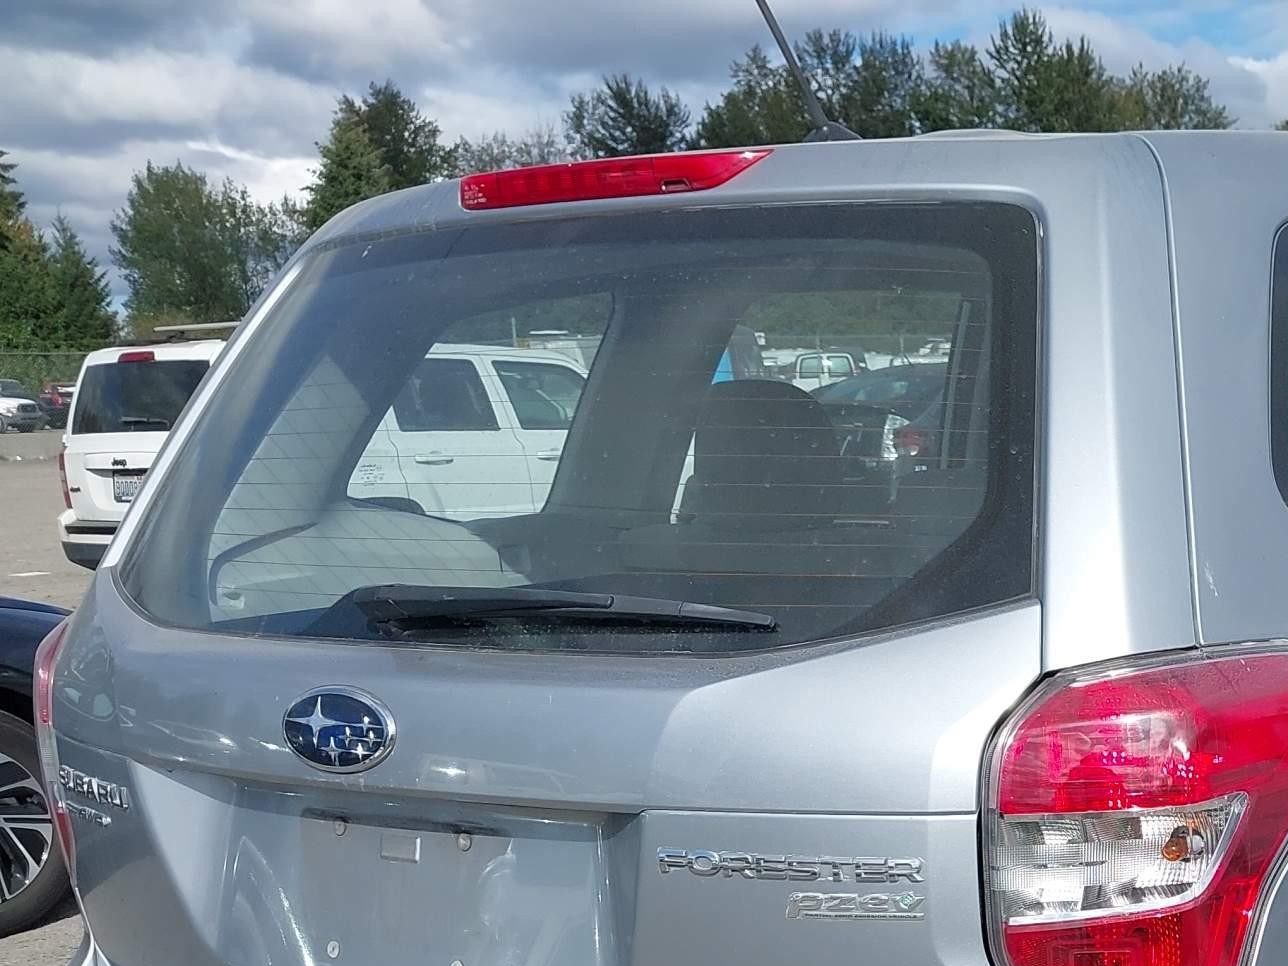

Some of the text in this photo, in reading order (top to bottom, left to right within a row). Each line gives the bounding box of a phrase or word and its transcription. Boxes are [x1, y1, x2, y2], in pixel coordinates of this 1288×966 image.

[111, 456, 127, 467] Jeep
[59, 764, 128, 808] SUBARU
[657, 847, 925, 883] FORESTER
